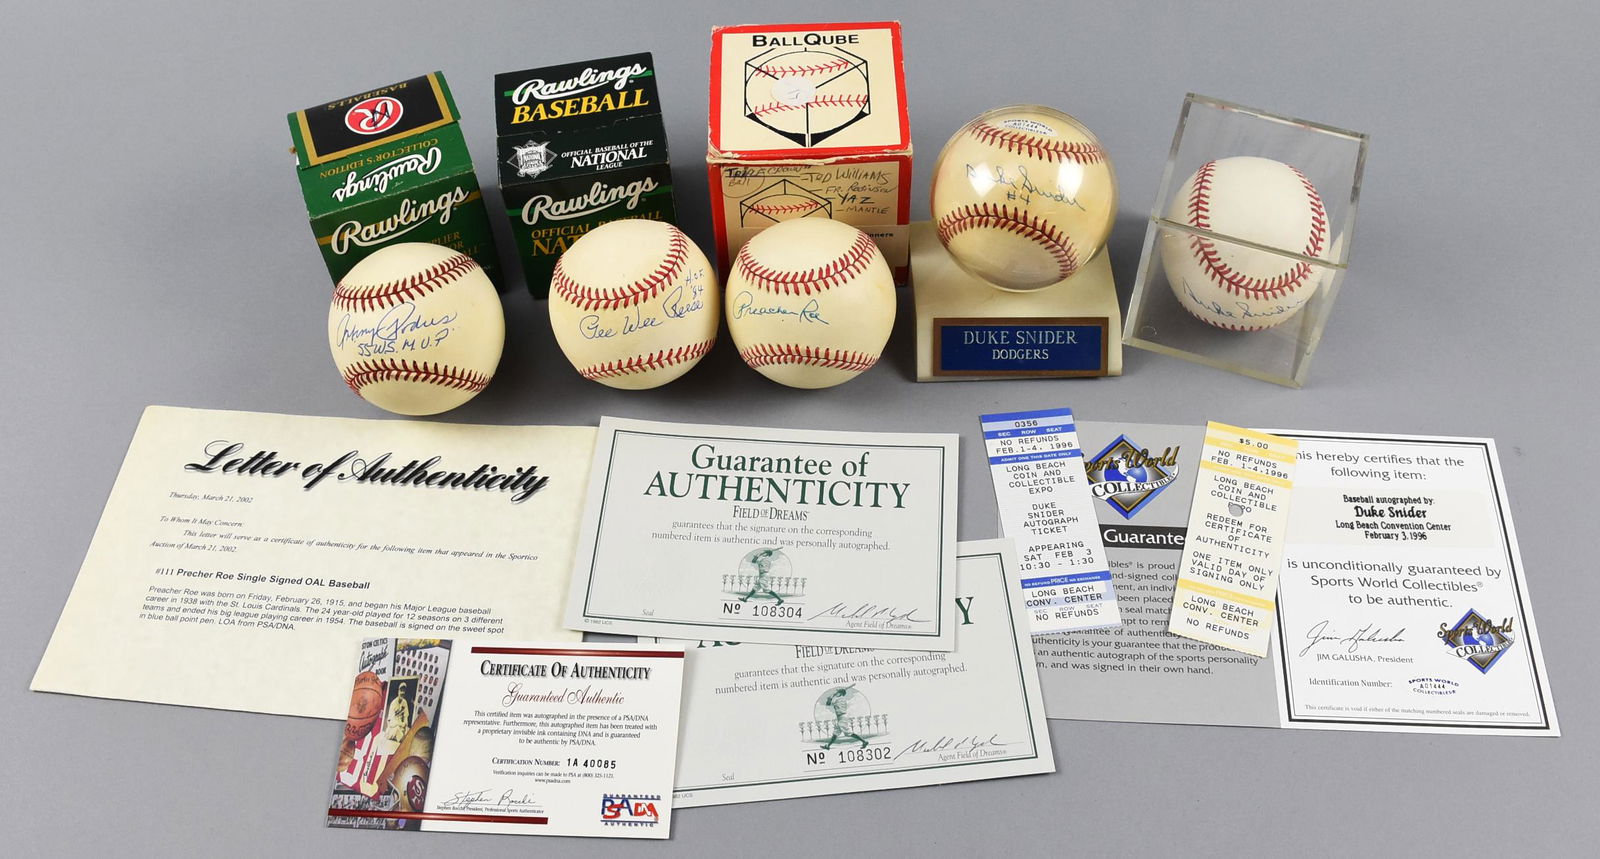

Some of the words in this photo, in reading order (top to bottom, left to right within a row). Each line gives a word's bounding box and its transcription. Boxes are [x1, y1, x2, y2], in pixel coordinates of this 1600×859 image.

[512, 63, 647, 105] Rawlings
[328, 83, 408, 110] BASEBALLS
[511, 89, 649, 124] BASEBALL
[561, 149, 592, 158] OFFICIAL
[595, 144, 628, 153] BASEBALL
[570, 147, 647, 168] NATIONAL
[320, 158, 364, 178] EDITION
[596, 162, 623, 171] LEAGUE
[333, 148, 441, 202] Rawlings
[522, 177, 658, 225] Rawlings
[331, 186, 469, 255] Rawlings
[531, 223, 590, 239] OFFICIAL
[964, 331, 1010, 344] DUKE
[1016, 331, 1078, 344] SNIDER
[992, 349, 1049, 360] DODGERS
[1018, 436, 1059, 444] REFUNDS
[1239, 438, 1268, 449] $5.00
[691, 443, 832, 476] Guarantee
[841, 451, 869, 477] of
[1121, 446, 1180, 469] World
[1236, 454, 1277, 468] REFUNDS
[1316, 452, 1359, 463] hereby
[1364, 454, 1412, 465] certifies
[1417, 456, 1440, 466] that
[1444, 457, 1465, 466] the
[184, 440, 301, 478] Letter
[302, 451, 358, 491] of
[338, 452, 550, 504] Authenticity
[1331, 467, 1390, 481] following
[1394, 471, 1426, 480] item:
[643, 471, 910, 509] AUTHENTICITY
[1009, 476, 1075, 488] COLLECTIBLE
[1214, 476, 1237, 485] LONG
[1244, 482, 1274, 494] BEACH
[202, 494, 223, 502] March
[1218, 484, 1242, 494] COIN
[1248, 492, 1266, 500] AND
[1343, 495, 1374, 503] Baseball
[1376, 496, 1422, 505] autographed
[1032, 502, 1056, 510] DUKE
[1211, 490, 1277, 511] COLLECTIBLE
[733, 505, 759, 519] FIELD
[1028, 510, 1064, 519] SNIDER
[1354, 506, 1385, 518] Duke
[1388, 507, 1427, 518] Snider
[672, 521, 714, 530] guarantees
[717, 522, 733, 531] that
[735, 523, 748, 531] the
[750, 523, 786, 534] signature
[801, 526, 813, 535] the
[816, 529, 872, 538] corresponding
[1024, 516, 1078, 528] AUTOGRAPH
[1207, 513, 1242, 527] REDEEM
[1249, 524, 1268, 533] FOR
[1336, 520, 1354, 529] Long
[1357, 521, 1379, 529] Beach
[1381, 521, 1424, 530] Convention
[1426, 522, 1451, 531] Center
[1032, 526, 1068, 535] TICKET
[1104, 529, 1184, 545] Guarante
[1205, 521, 1272, 543] CERTIFICATE
[1365, 531, 1399, 541] February
[1028, 541, 1084, 552] APPEARING
[1196, 535, 1269, 558] AUTHENTICITY
[1020, 562, 1051, 570] 10:30
[1071, 557, 1094, 566] 1:30
[1192, 559, 1222, 572] VALID
[1229, 568, 1247, 578] DAY
[1193, 551, 1211, 561] ONE
[1219, 558, 1242, 568] ITEM
[1249, 565, 1273, 576] ONLY
[1303, 560, 1402, 575] unconditionally
[1408, 566, 1481, 577] guaranteed
[1486, 567, 1501, 579] by
[176, 569, 214, 579] Precher
[215, 571, 234, 581] Roe
[237, 573, 267, 584] Single
[269, 575, 303, 585] Signed
[305, 578, 326, 586] OAL
[328, 579, 370, 590] Baseball
[1190, 567, 1233, 583] SIGNING
[1240, 580, 1264, 591] ONLY
[1311, 575, 1354, 588] Sports
[1358, 577, 1398, 588] World
[1026, 598, 1057, 607] CONV.
[1065, 593, 1102, 603] CENTER
[1032, 589, 1056, 598] LONG
[1063, 586, 1094, 594] BEACH
[1191, 596, 1216, 607] LONG
[1223, 604, 1254, 616] BEACH
[1349, 594, 1362, 604] to
[1367, 594, 1383, 604] be
[1387, 596, 1453, 607] authentic.
[753, 604, 803, 619] 108304
[1056, 609, 1099, 619] REFUNDS
[1183, 602, 1212, 615] CONV.
[1221, 612, 1258, 626] CENTER
[1186, 618, 1199, 626] NO
[1206, 622, 1250, 639] REFUNDS
[1114, 641, 1160, 650] guarantee
[1051, 650, 1094, 658] authentic
[1096, 652, 1145, 662] autograph
[1176, 654, 1204, 663] sports
[1207, 655, 1258, 666] personality
[1317, 654, 1330, 662] JIM
[1332, 654, 1375, 663] GALUSHA,
[480, 660, 547, 677] CERTIFICATE
[570, 662, 651, 680] AUTHENTICITY
[868, 669, 911, 683] personally
[913, 663, 968, 678] autographed.
[1309, 678, 1360, 687] Identification
[502, 682, 568, 707] Guaranteed
[567, 684, 625, 705] Authentic
[567, 757, 579, 768] 1A
[583, 759, 617, 769] 40085
[838, 747, 891, 764] 108302
